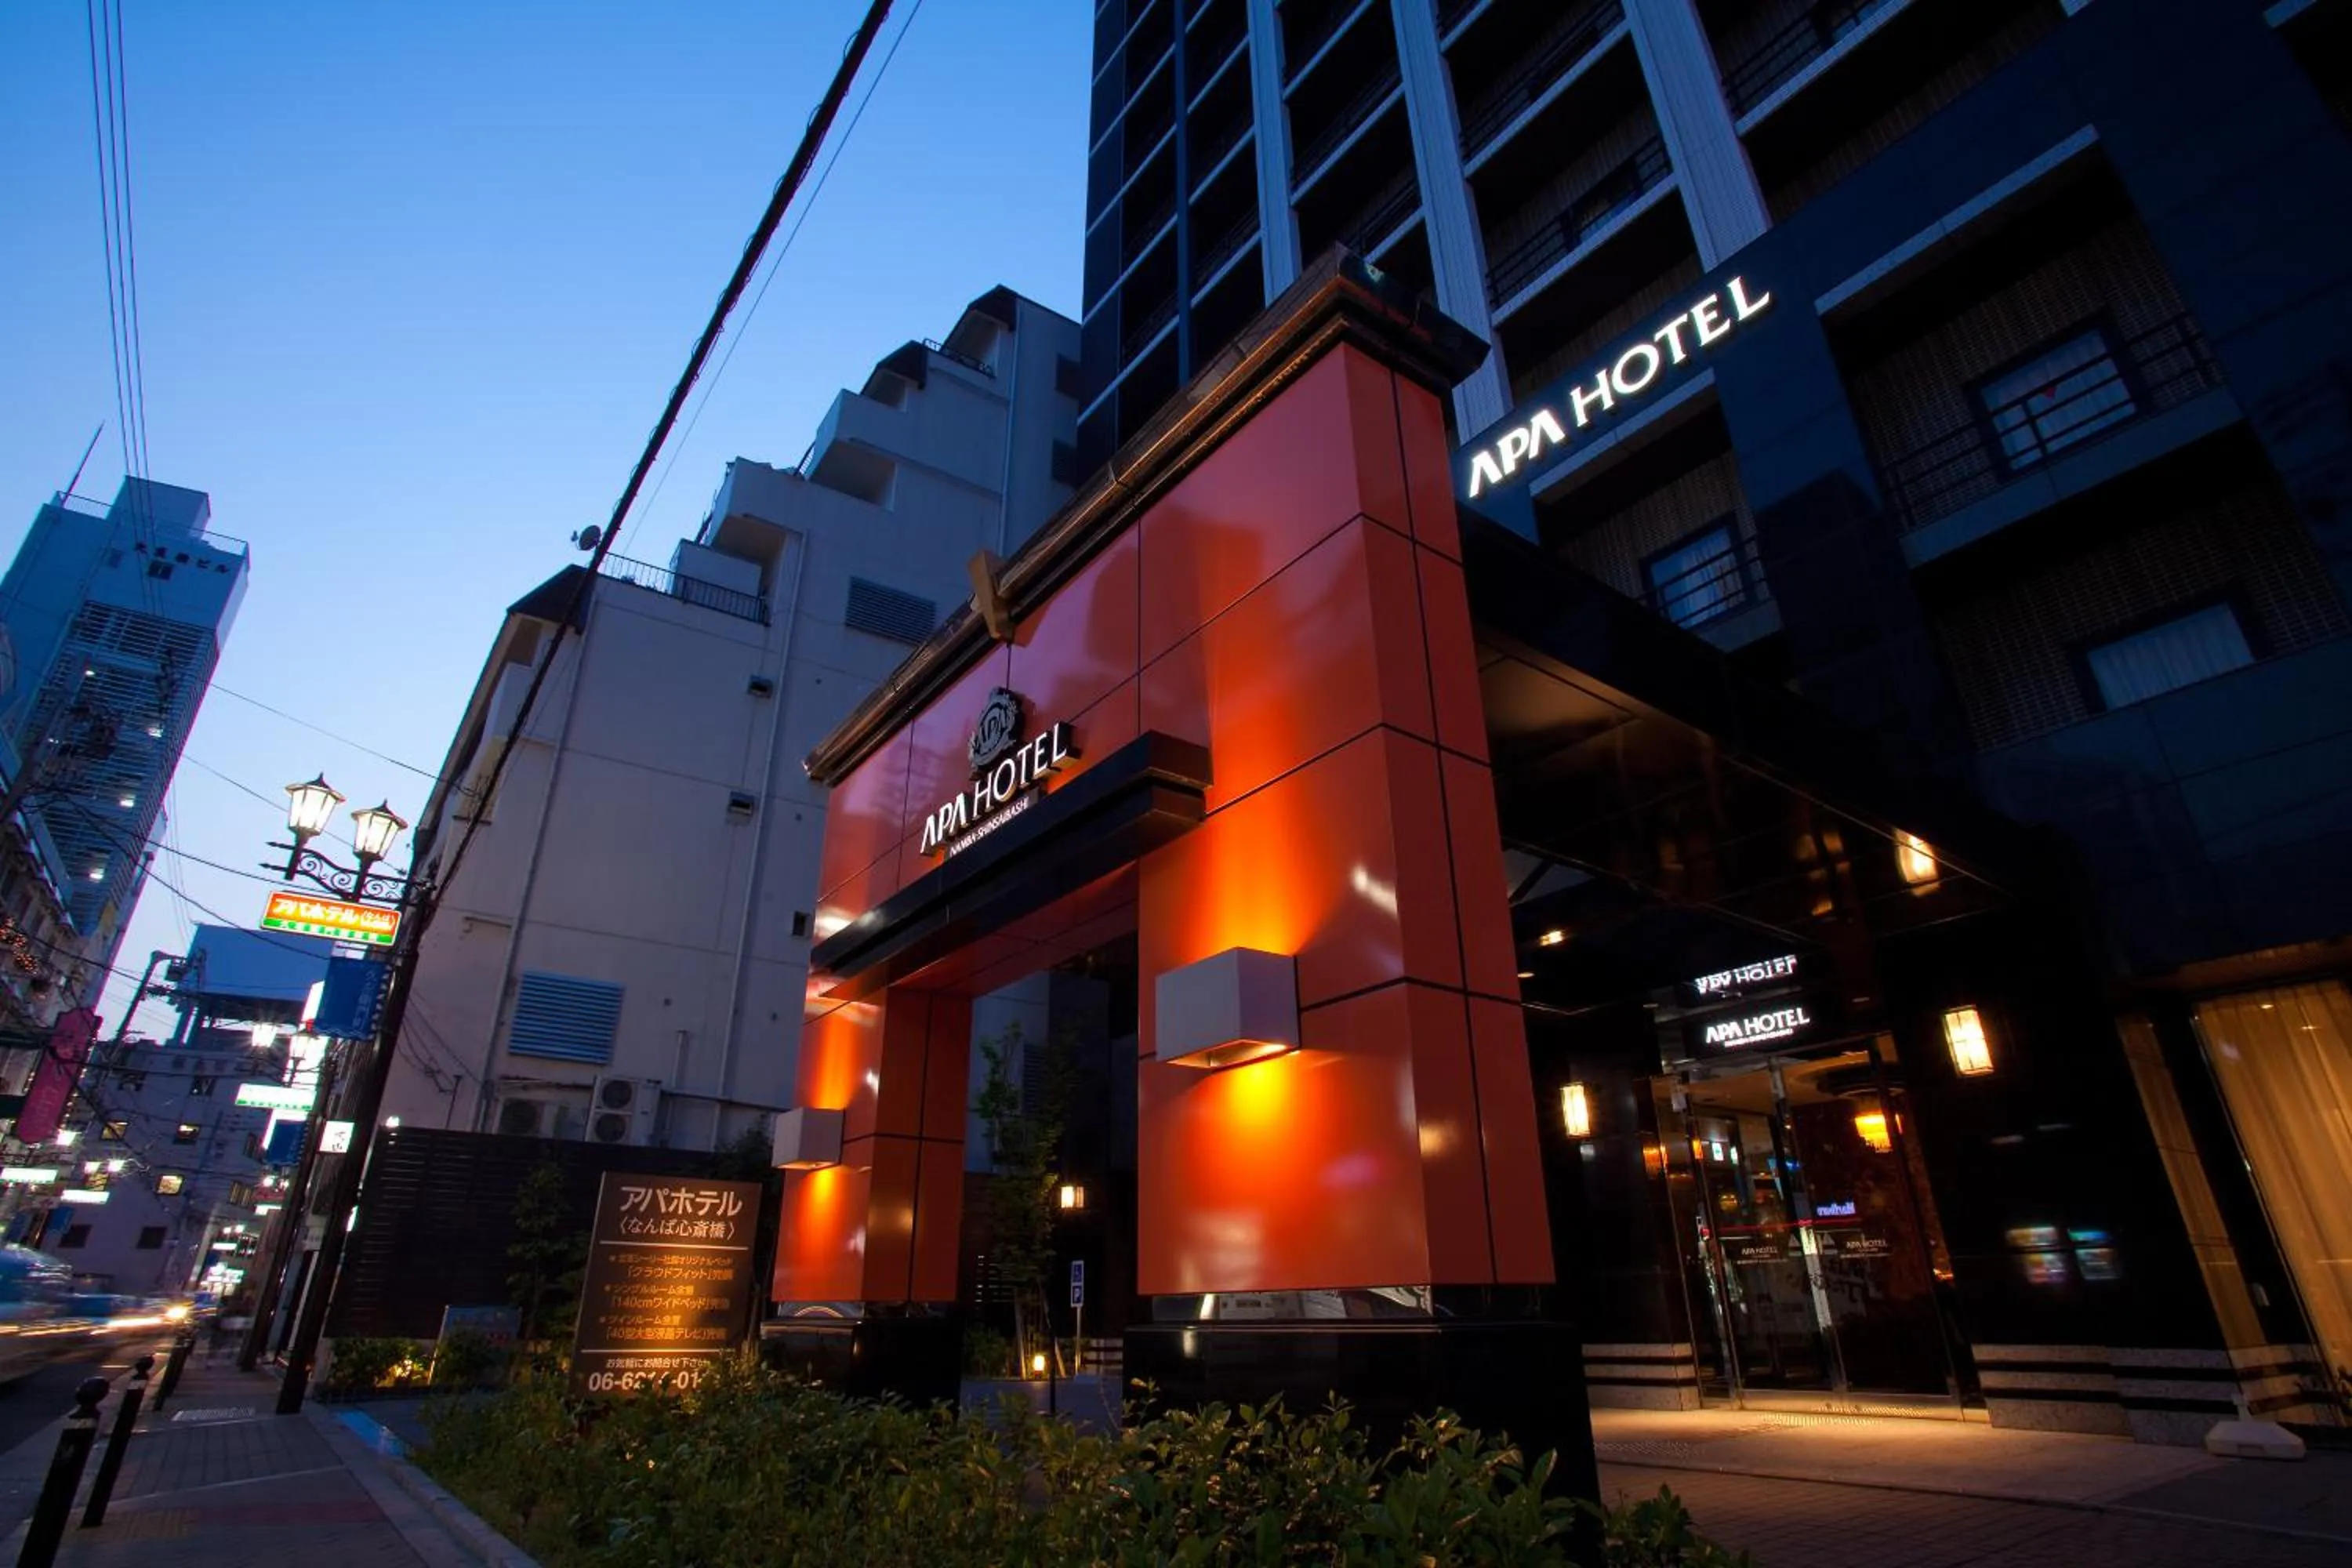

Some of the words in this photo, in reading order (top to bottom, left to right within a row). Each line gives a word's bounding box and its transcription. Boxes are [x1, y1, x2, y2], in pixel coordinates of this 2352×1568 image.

[1469, 409, 1566, 499] APA
[1570, 275, 1770, 427] HOTEL
[920, 792, 968, 854] APA
[973, 721, 1068, 821] HOTEL
[1706, 1022, 1743, 1044] APA
[1744, 1007, 1811, 1035] HOTEL
[619, 1185, 743, 1216] アパホテル
